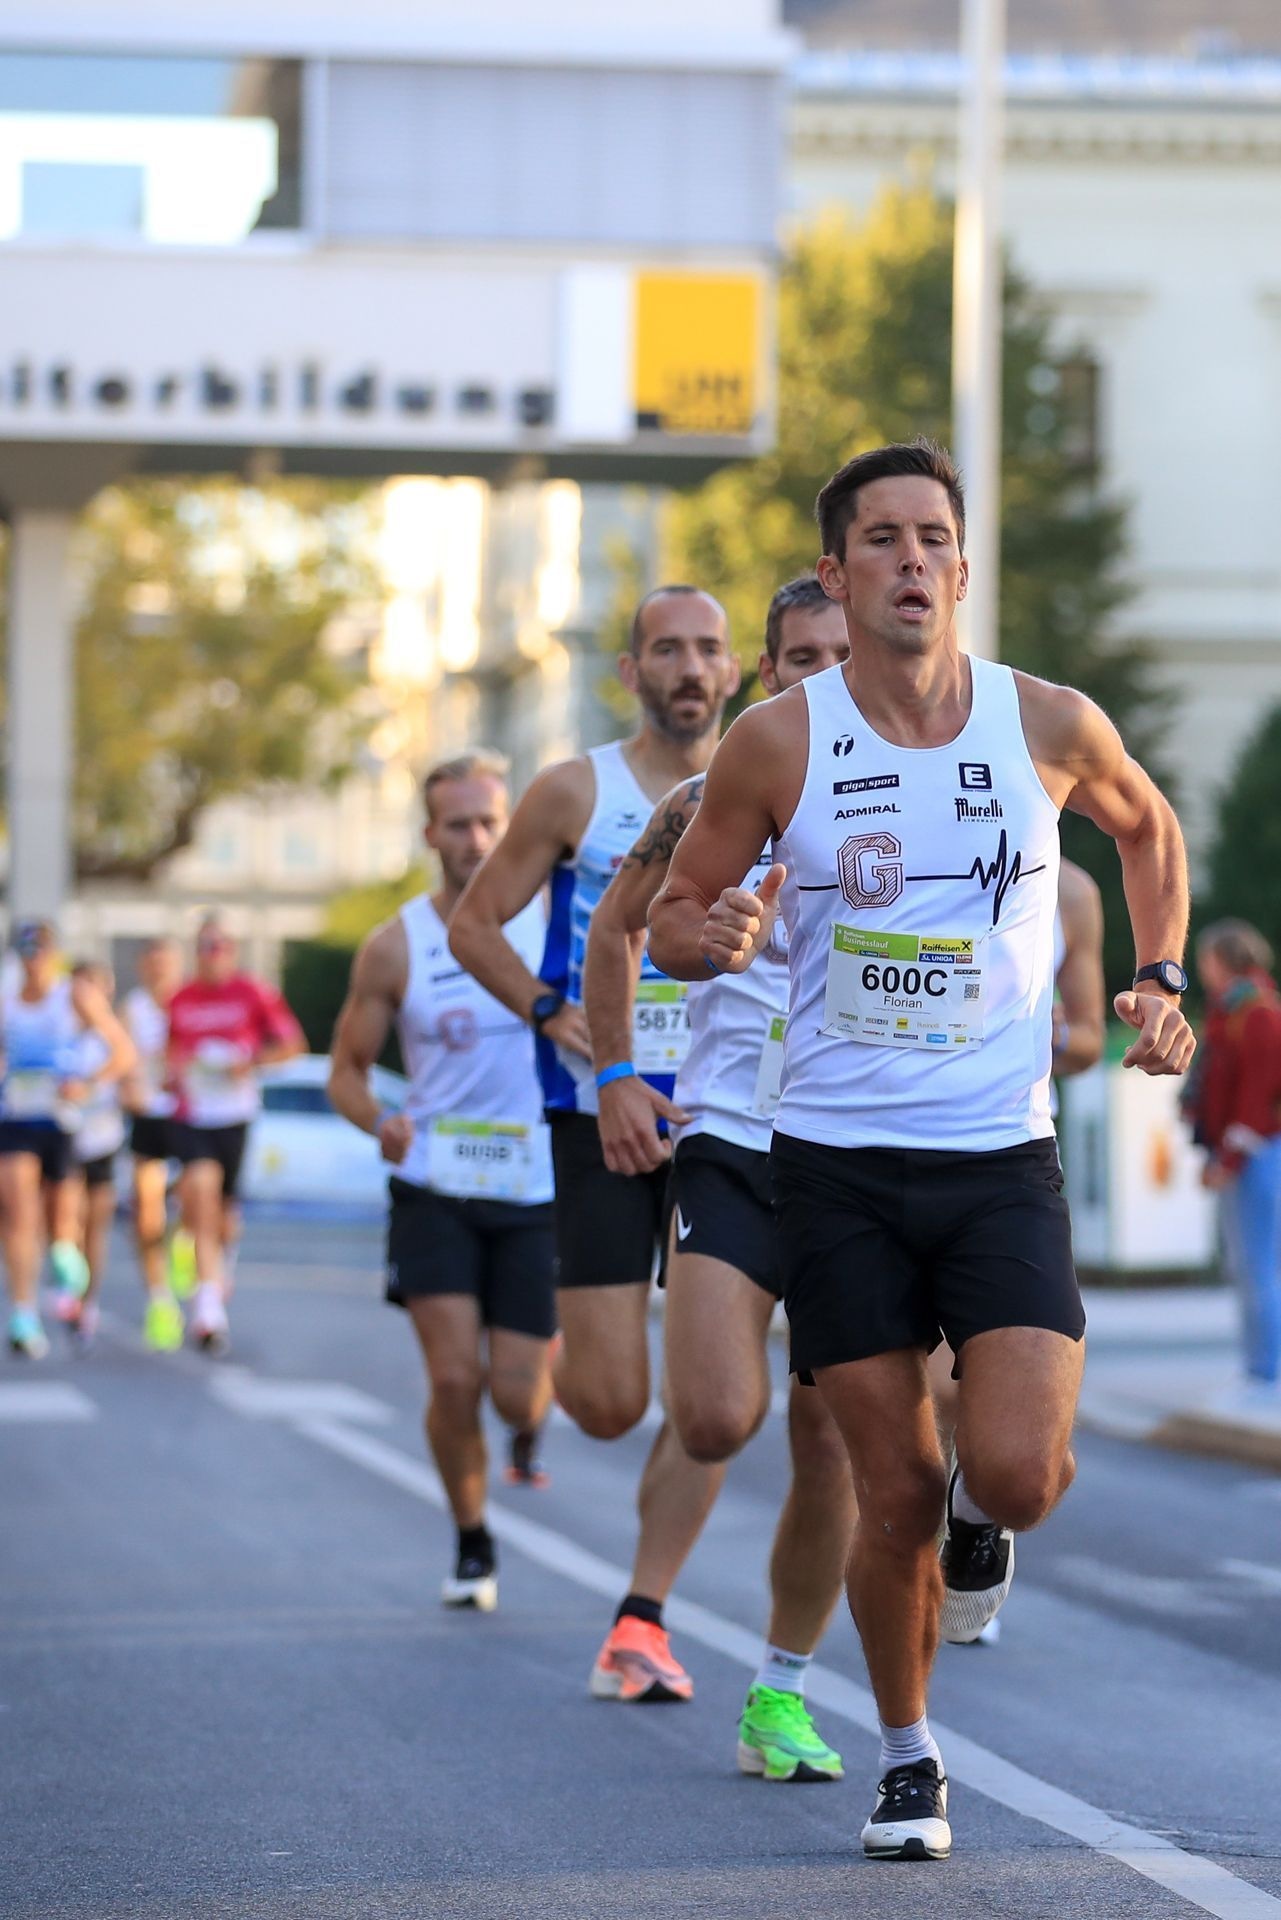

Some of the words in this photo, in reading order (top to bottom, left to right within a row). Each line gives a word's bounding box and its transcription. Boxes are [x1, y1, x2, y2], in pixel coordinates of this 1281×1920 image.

[834, 803, 902, 820] ADMIRAL
[954, 798, 1003, 822] Murelli
[837, 832, 903, 910] G
[843, 935, 889, 948] Businesslauf
[921, 943, 961, 953] Raiffeisen
[931, 954, 954, 963] UNIQA
[862, 964, 948, 996] 600C
[883, 996, 923, 1009] Florian
